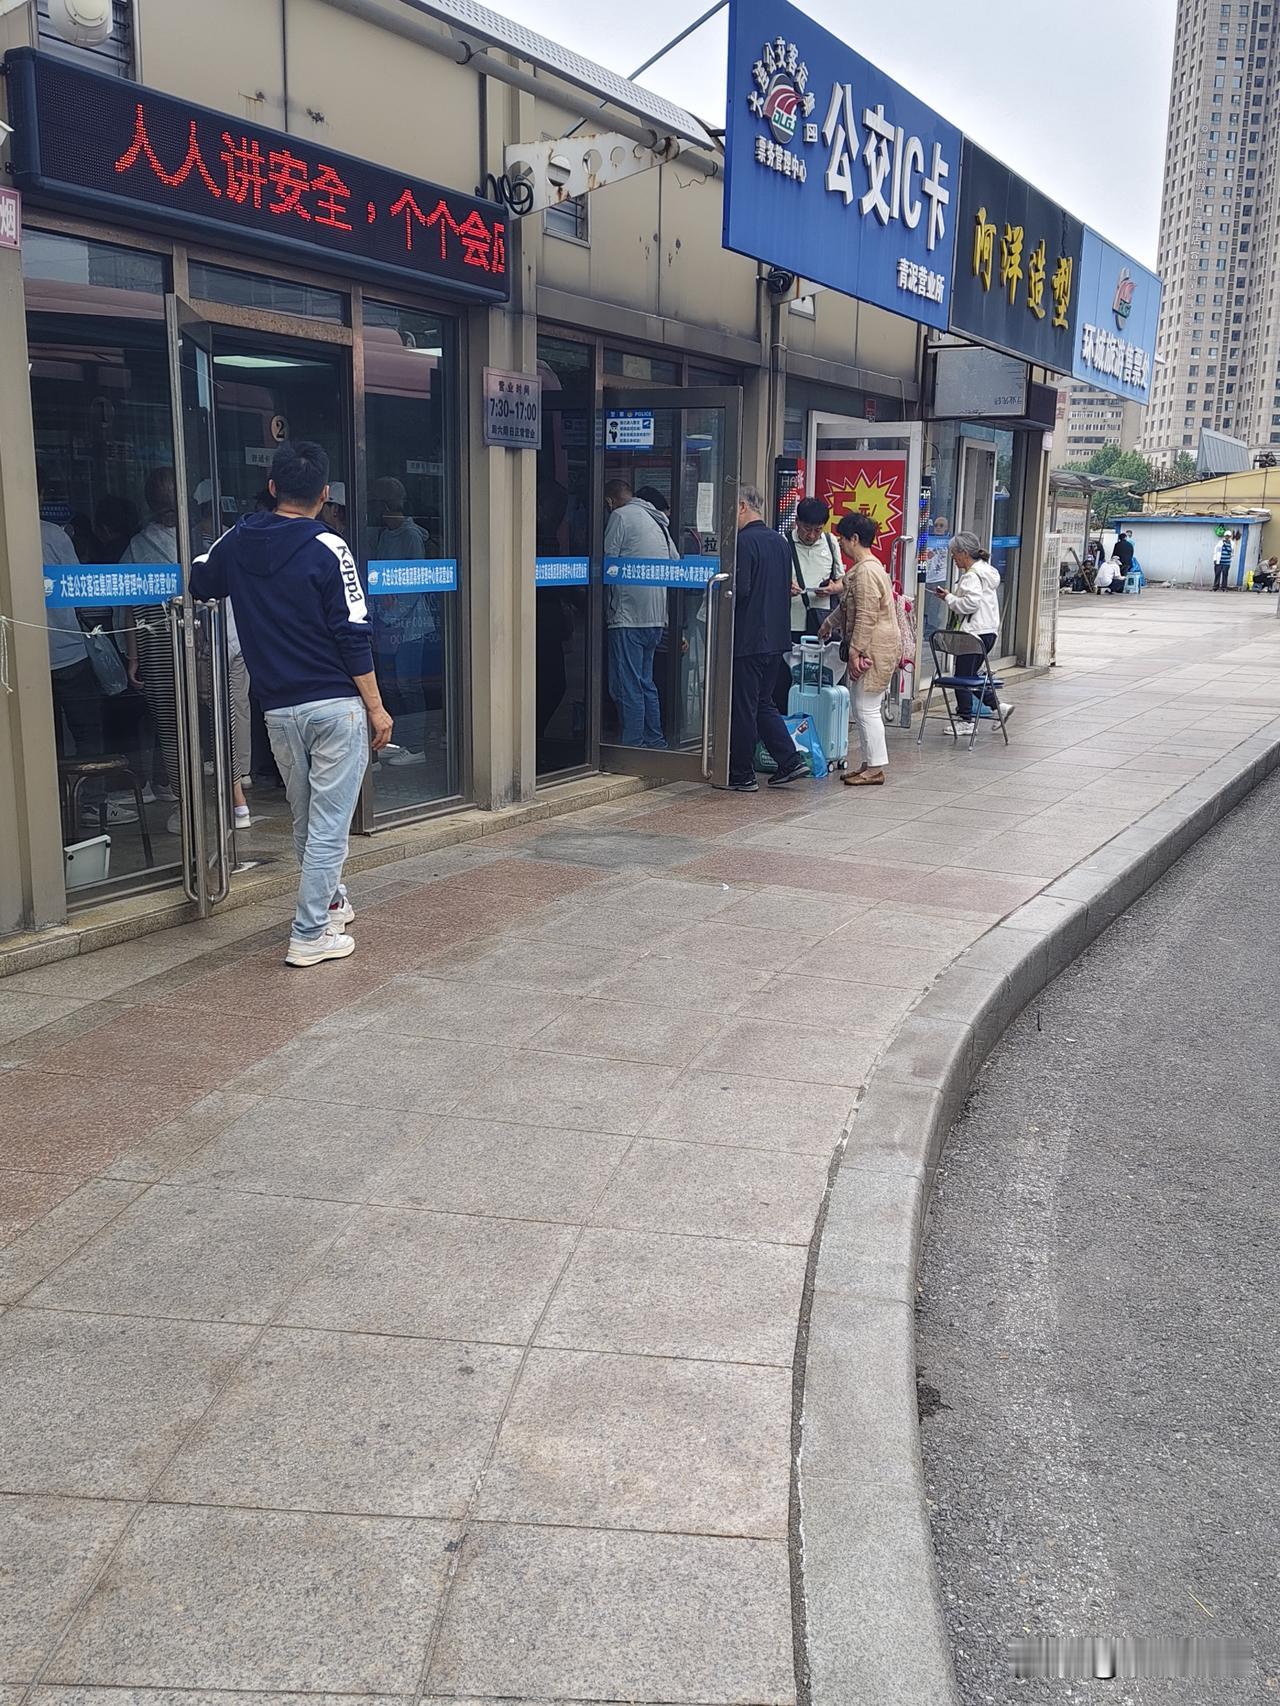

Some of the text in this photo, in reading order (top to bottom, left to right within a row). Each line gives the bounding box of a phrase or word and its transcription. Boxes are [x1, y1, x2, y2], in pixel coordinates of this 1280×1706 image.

[755, 134, 807, 183] 票务管理中心
[822, 81, 950, 251] 公交IC卡
[897, 257, 946, 304] 青泥营业所
[498, 380, 530, 396] 营业时间
[490, 397, 537, 421] 7:30-17:00
[275, 420, 286, 439] 2
[704, 536, 718, 553] 拉
[336, 545, 363, 604] Kappa
